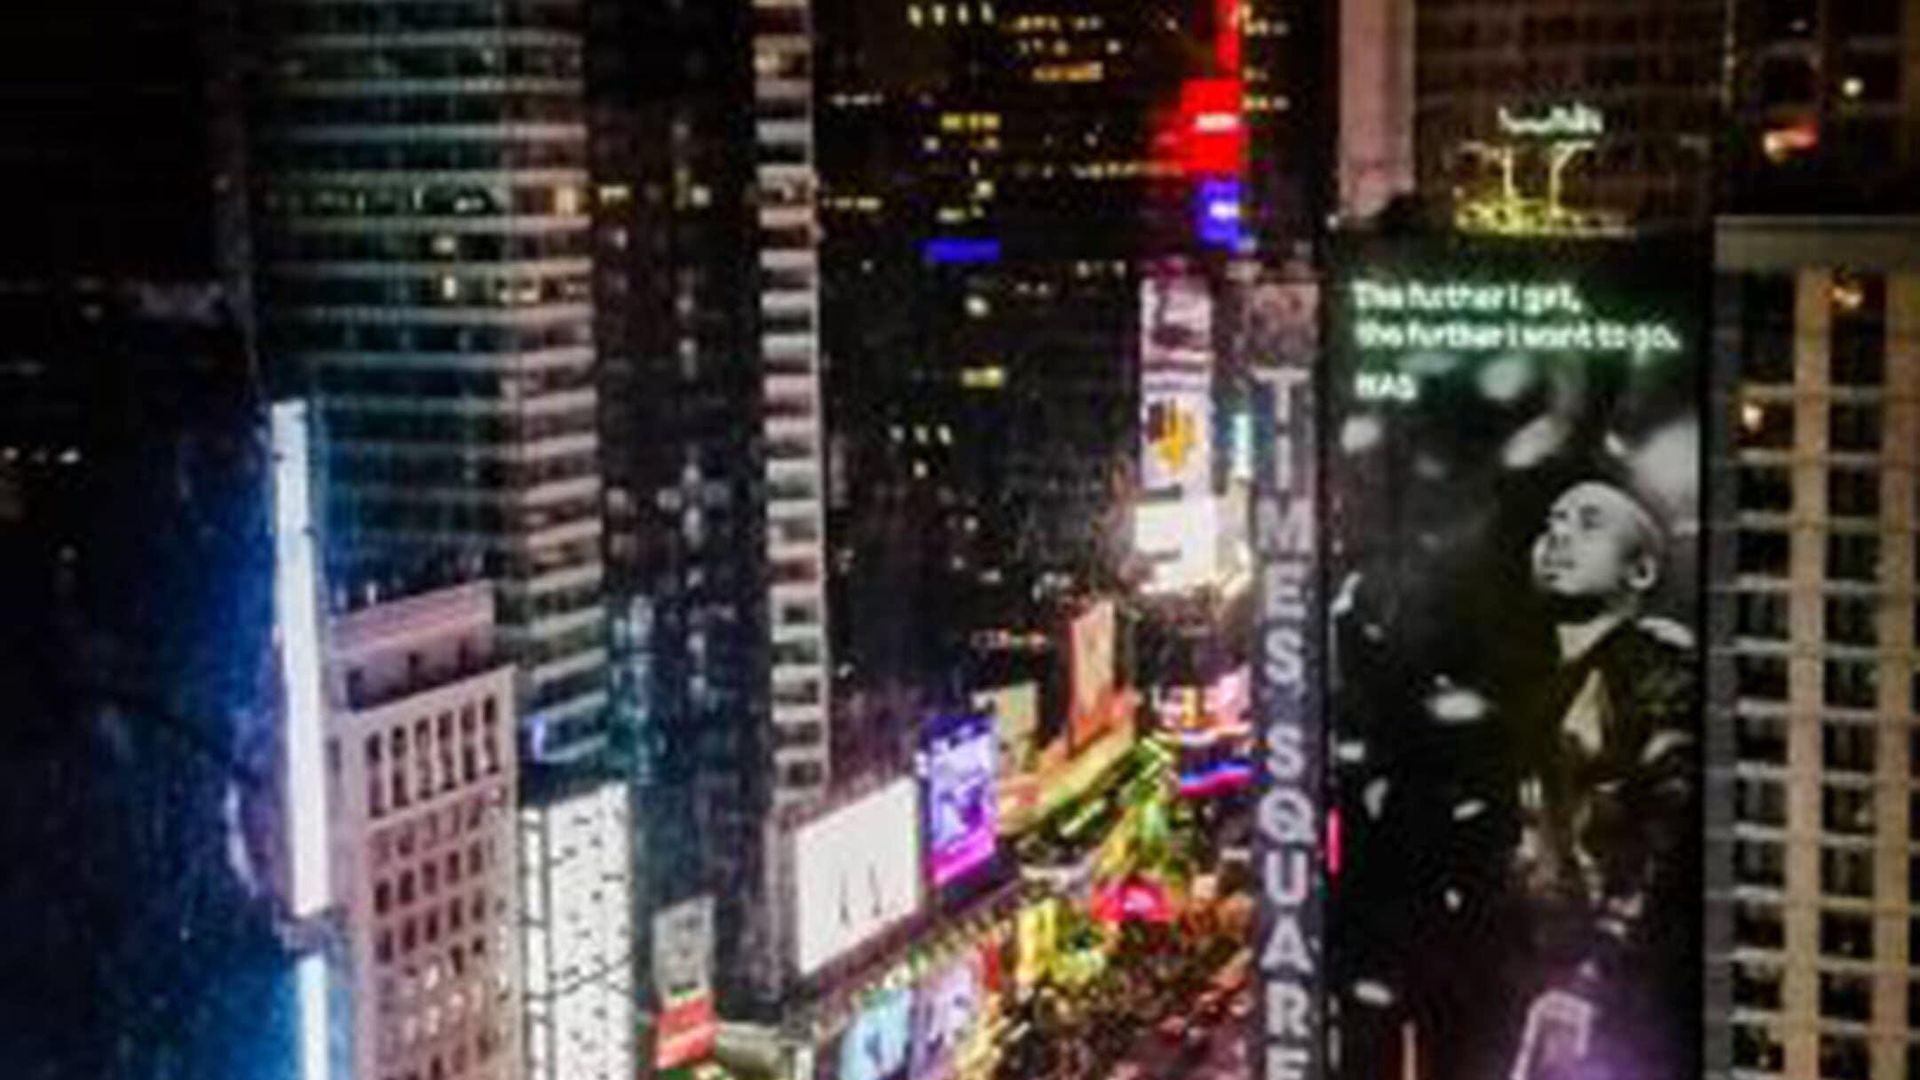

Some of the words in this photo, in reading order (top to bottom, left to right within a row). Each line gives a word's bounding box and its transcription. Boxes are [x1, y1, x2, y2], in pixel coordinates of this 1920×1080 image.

[1353, 281, 1403, 308] The
[1508, 283, 1520, 308] I
[1408, 320, 1504, 348] further
[1507, 321, 1519, 347] I
[1522, 322, 1593, 349] want
[1595, 321, 1627, 349] to
[1254, 365, 1313, 684] TIMES
[1258, 724, 1319, 1080] SQUARE
